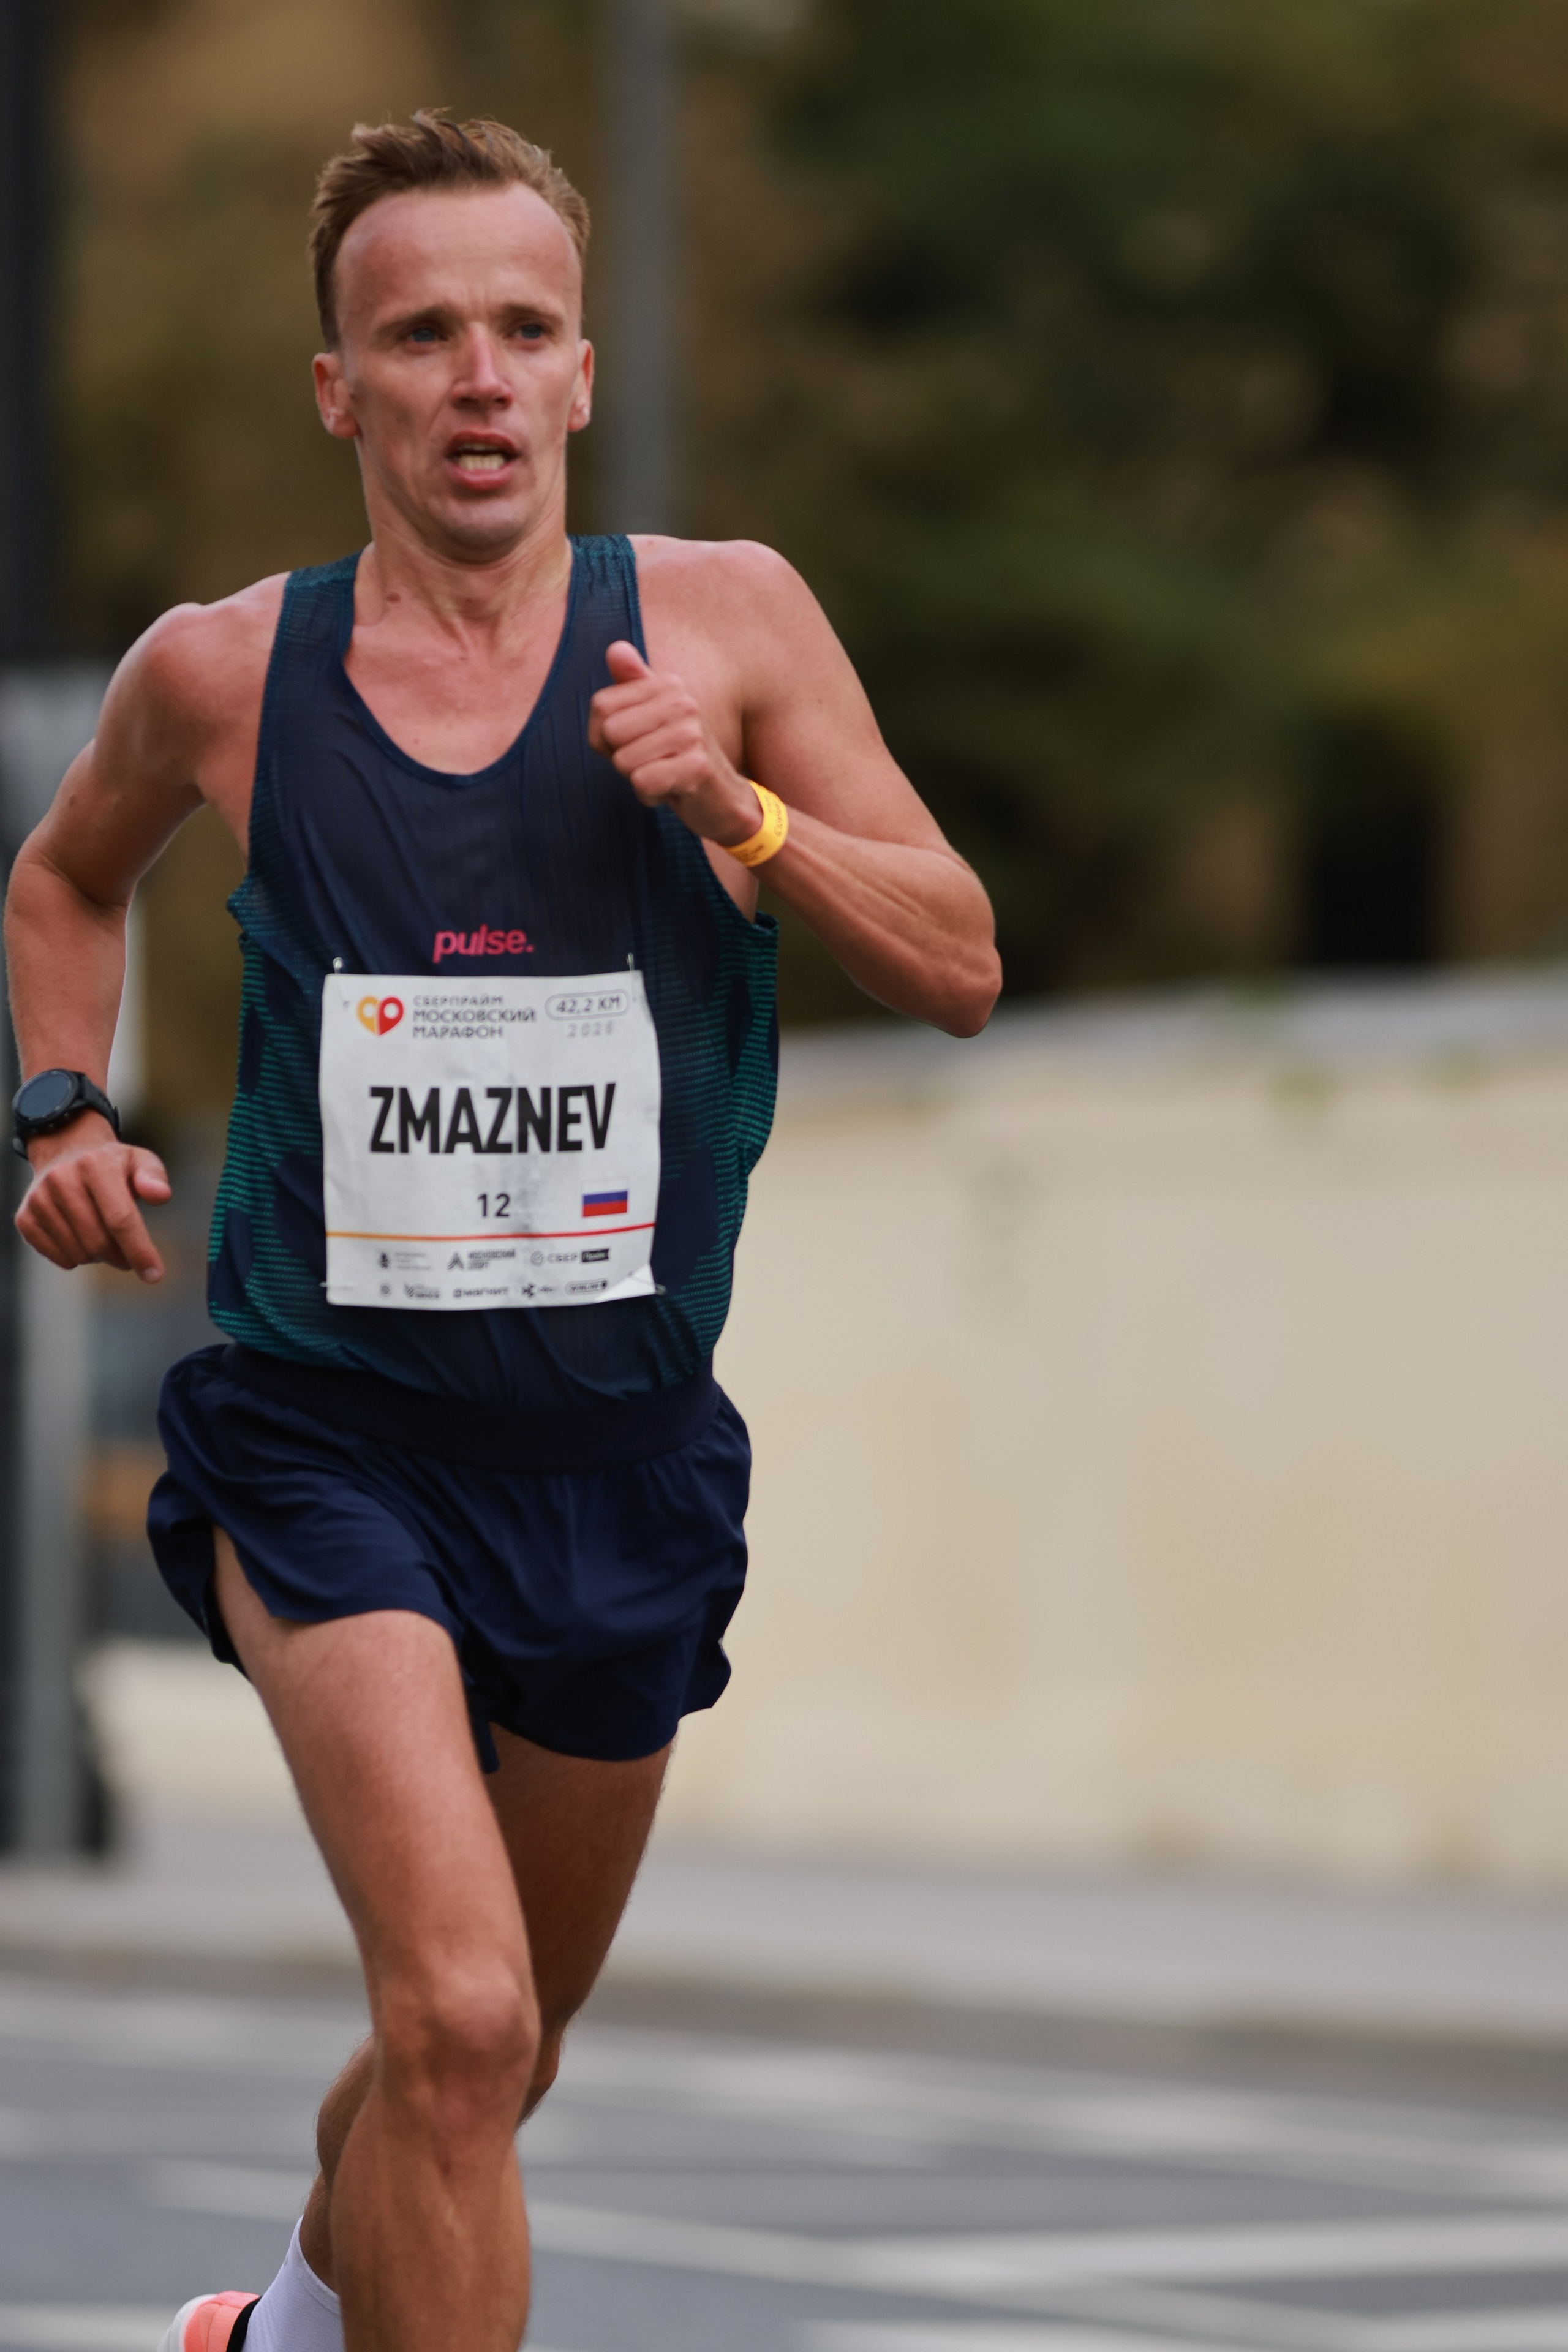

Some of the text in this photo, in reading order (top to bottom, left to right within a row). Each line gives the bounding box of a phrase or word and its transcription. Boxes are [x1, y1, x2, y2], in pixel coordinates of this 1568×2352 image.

[432, 924, 535, 964] pulse.
[413, 993, 504, 1008] СБЕРПРАЙМ
[556, 994, 622, 1014] 42,2 КМ
[413, 1006, 537, 1023] МОСКОВСКИЙ
[413, 1025, 503, 1039] МАРАФОН
[369, 1082, 616, 1154] ZMAZNEV
[477, 1193, 511, 1218] 12
